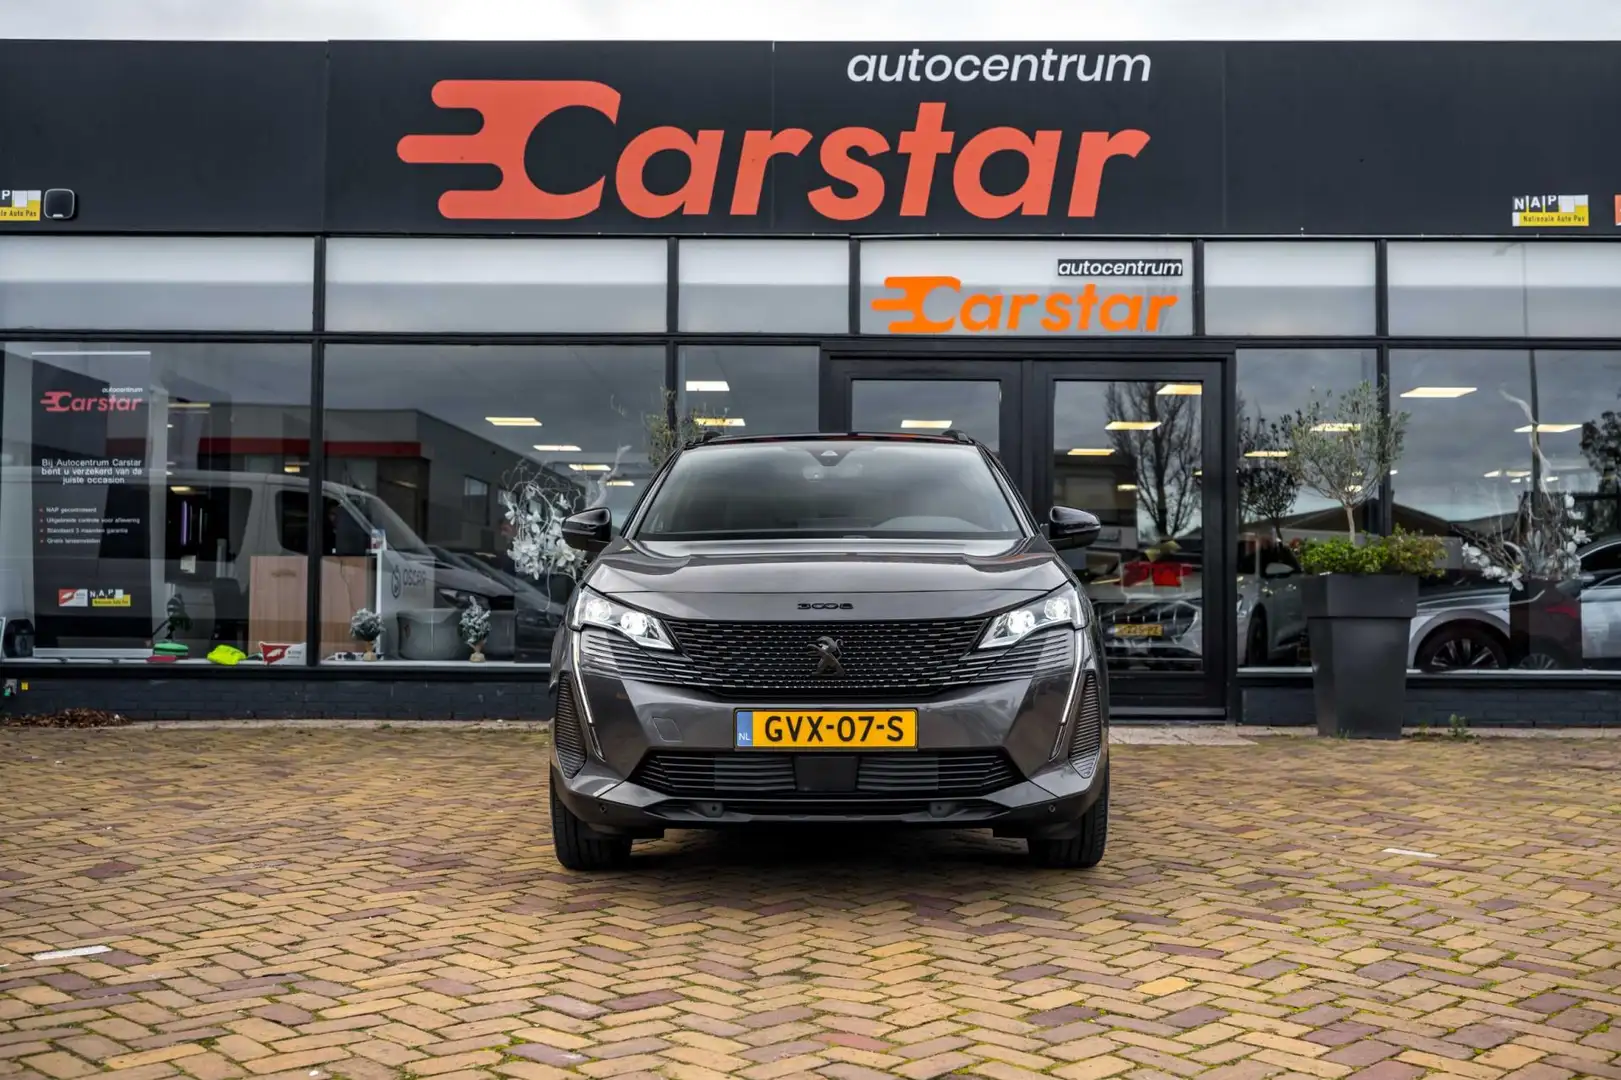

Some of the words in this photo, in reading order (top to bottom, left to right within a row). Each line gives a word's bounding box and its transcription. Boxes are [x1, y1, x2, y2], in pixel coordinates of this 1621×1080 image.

[847, 48, 1151, 83] autocentrum
[397, 79, 1150, 221] Carstar
[1058, 260, 1183, 276] autocentrum
[870, 275, 1178, 334] Carstar
[40, 391, 143, 412] Carstar
[41, 458, 53, 468] Bij
[56, 458, 109, 467] Autocentrum
[112, 458, 142, 467] Carstar
[41, 467, 61, 475] bent
[72, 467, 113, 475] verzekerd
[132, 467, 142, 475] de
[62, 476, 84, 485] juiste
[86, 476, 125, 484] occasion
[738, 732, 751, 741] NL
[764, 716, 904, 743] GVX-07-S
